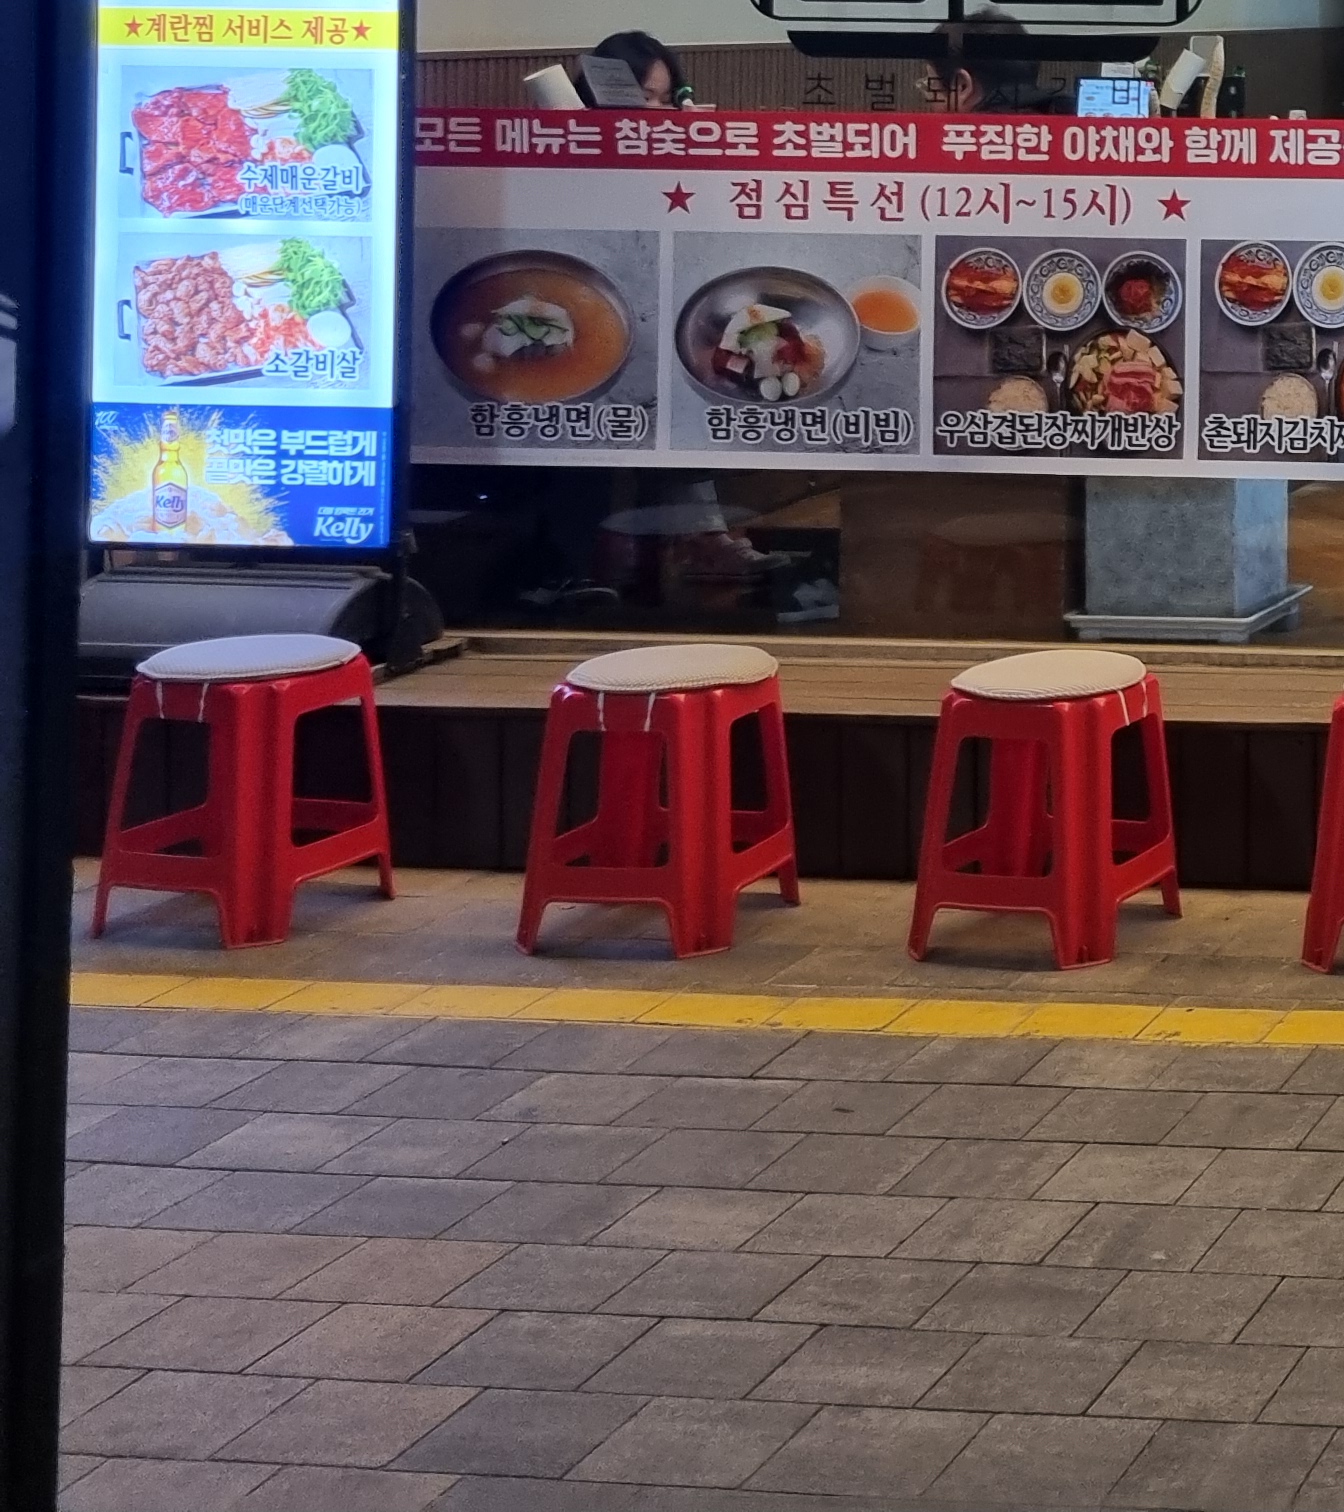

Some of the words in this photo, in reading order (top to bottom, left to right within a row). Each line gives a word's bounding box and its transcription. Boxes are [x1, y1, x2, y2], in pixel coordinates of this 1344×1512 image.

[145, 14, 215, 44] 계란찜
[222, 15, 293, 43] 서비스
[302, 17, 350, 45] 제공
[414, 117, 482, 153] 모든
[495, 118, 603, 156] 메뉴는
[614, 120, 761, 158] 참숯으로
[772, 122, 918, 160] 초벌되어
[942, 123, 1052, 162] 푸짐한
[1063, 126, 1174, 164] 야채와
[1184, 127, 1257, 166] 함께
[239, 164, 364, 193] 수제매운갈비
[237, 196, 363, 217] (매운단계선택가능)
[729, 179, 908, 223] 점심특선
[919, 183, 1133, 227] (12시~15시)
[266, 349, 360, 380] 소갈비살
[470, 404, 650, 441] 함흥냉면(물)
[705, 407, 912, 446] 함흥냉면(비빔)
[936, 411, 1180, 453] 우삼겹된장찌개반상
[206, 428, 278, 455] 첫맛은
[280, 430, 378, 457] 부드럽게
[206, 458, 278, 486] 끝맛은
[280, 460, 377, 487] 강렬하게
[156, 495, 184, 513] Kelly
[313, 516, 374, 545] Kelly
